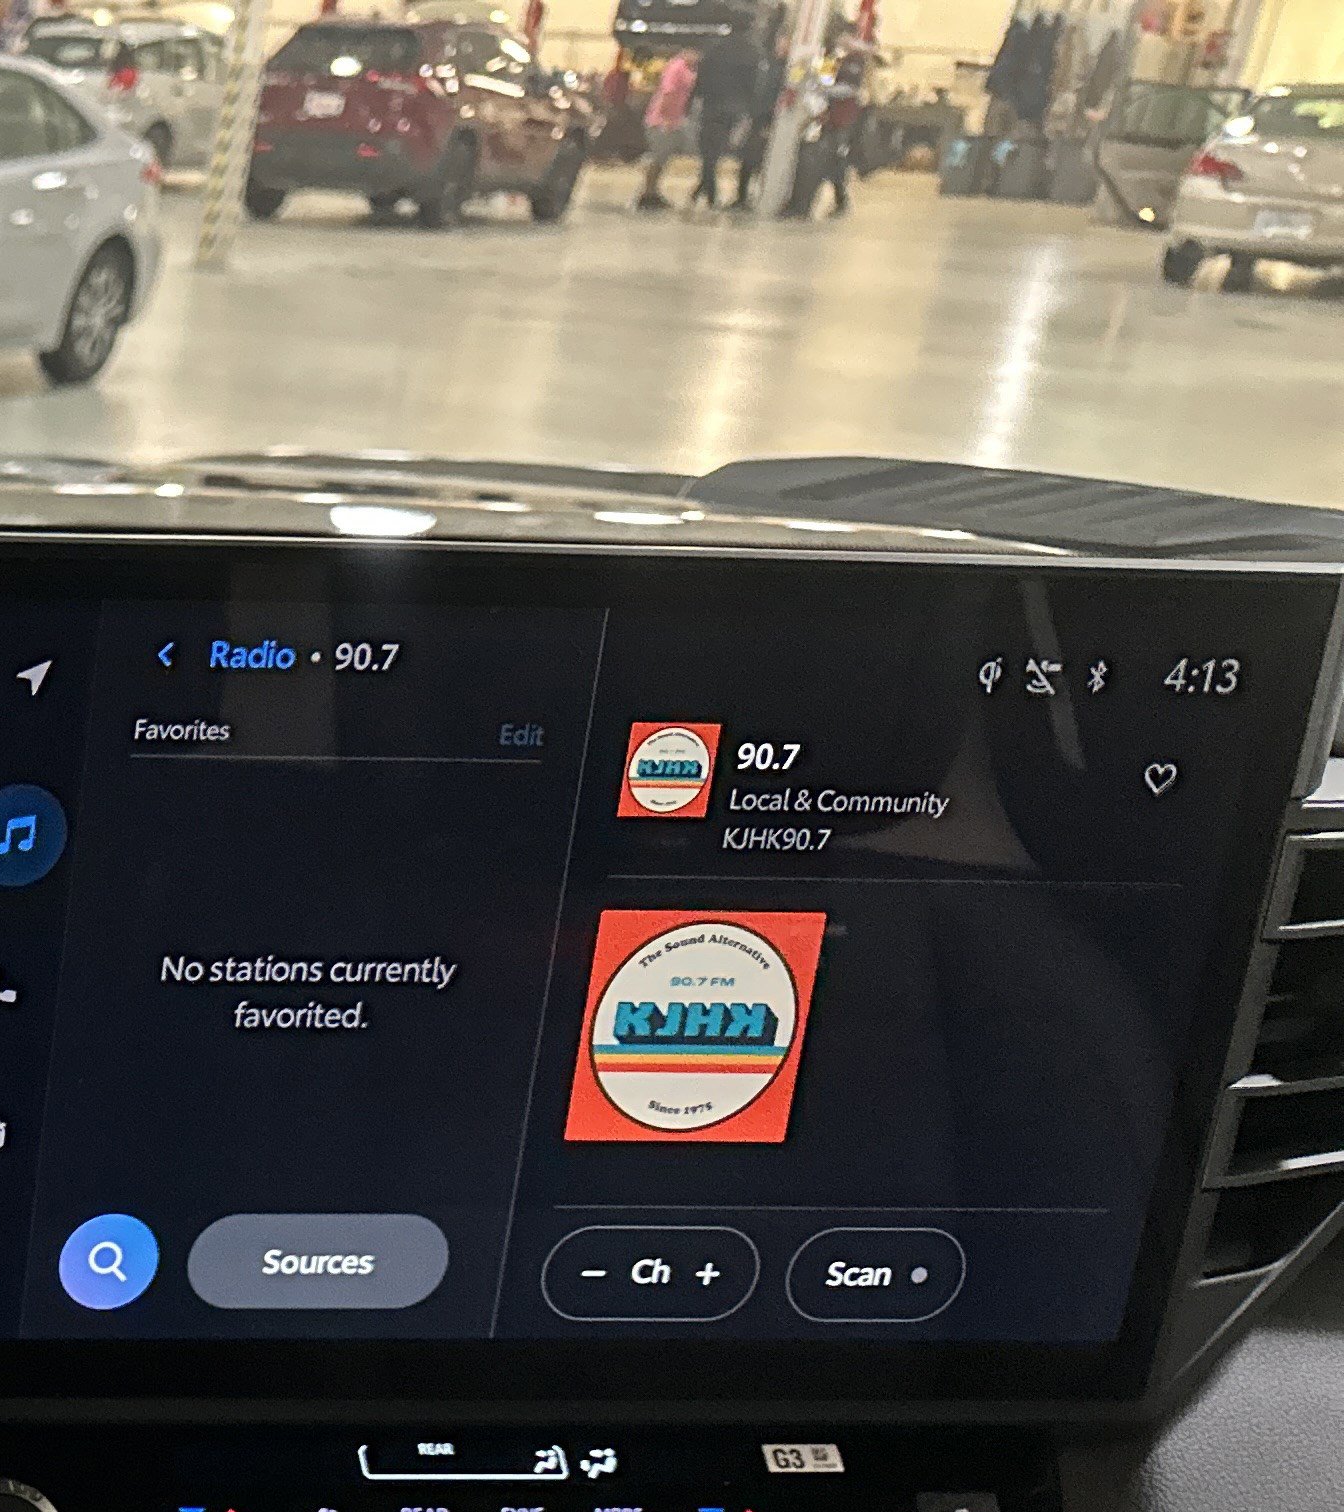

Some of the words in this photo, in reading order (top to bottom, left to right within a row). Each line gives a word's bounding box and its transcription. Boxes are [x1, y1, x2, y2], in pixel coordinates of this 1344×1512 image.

[210, 640, 296, 669] Radio
[334, 643, 400, 671] 90.7
[1163, 658, 1242, 694] 4:13
[133, 719, 231, 741] Favorites
[498, 723, 544, 747] Edit
[736, 743, 800, 771] 90.7
[729, 789, 793, 813] Local
[796, 791, 812, 813] &
[817, 789, 949, 818] Community
[722, 827, 832, 852] KJHK90.7
[638, 949, 662, 969] The
[664, 934, 705, 953] Sound
[708, 933, 770, 970] Alternative
[161, 956, 204, 982] No
[209, 955, 323, 982] stations
[329, 956, 458, 990] currently
[669, 976, 708, 987] 90.7
[709, 976, 736, 987] FM
[234, 1001, 368, 1029] favorited.
[647, 1100, 680, 1115] Since
[261, 1250, 374, 1276] Sources
[631, 1259, 671, 1285] Ch
[825, 1262, 892, 1288] Scan
[417, 1442, 454, 1456] REAR
[772, 1448, 805, 1469] G3
